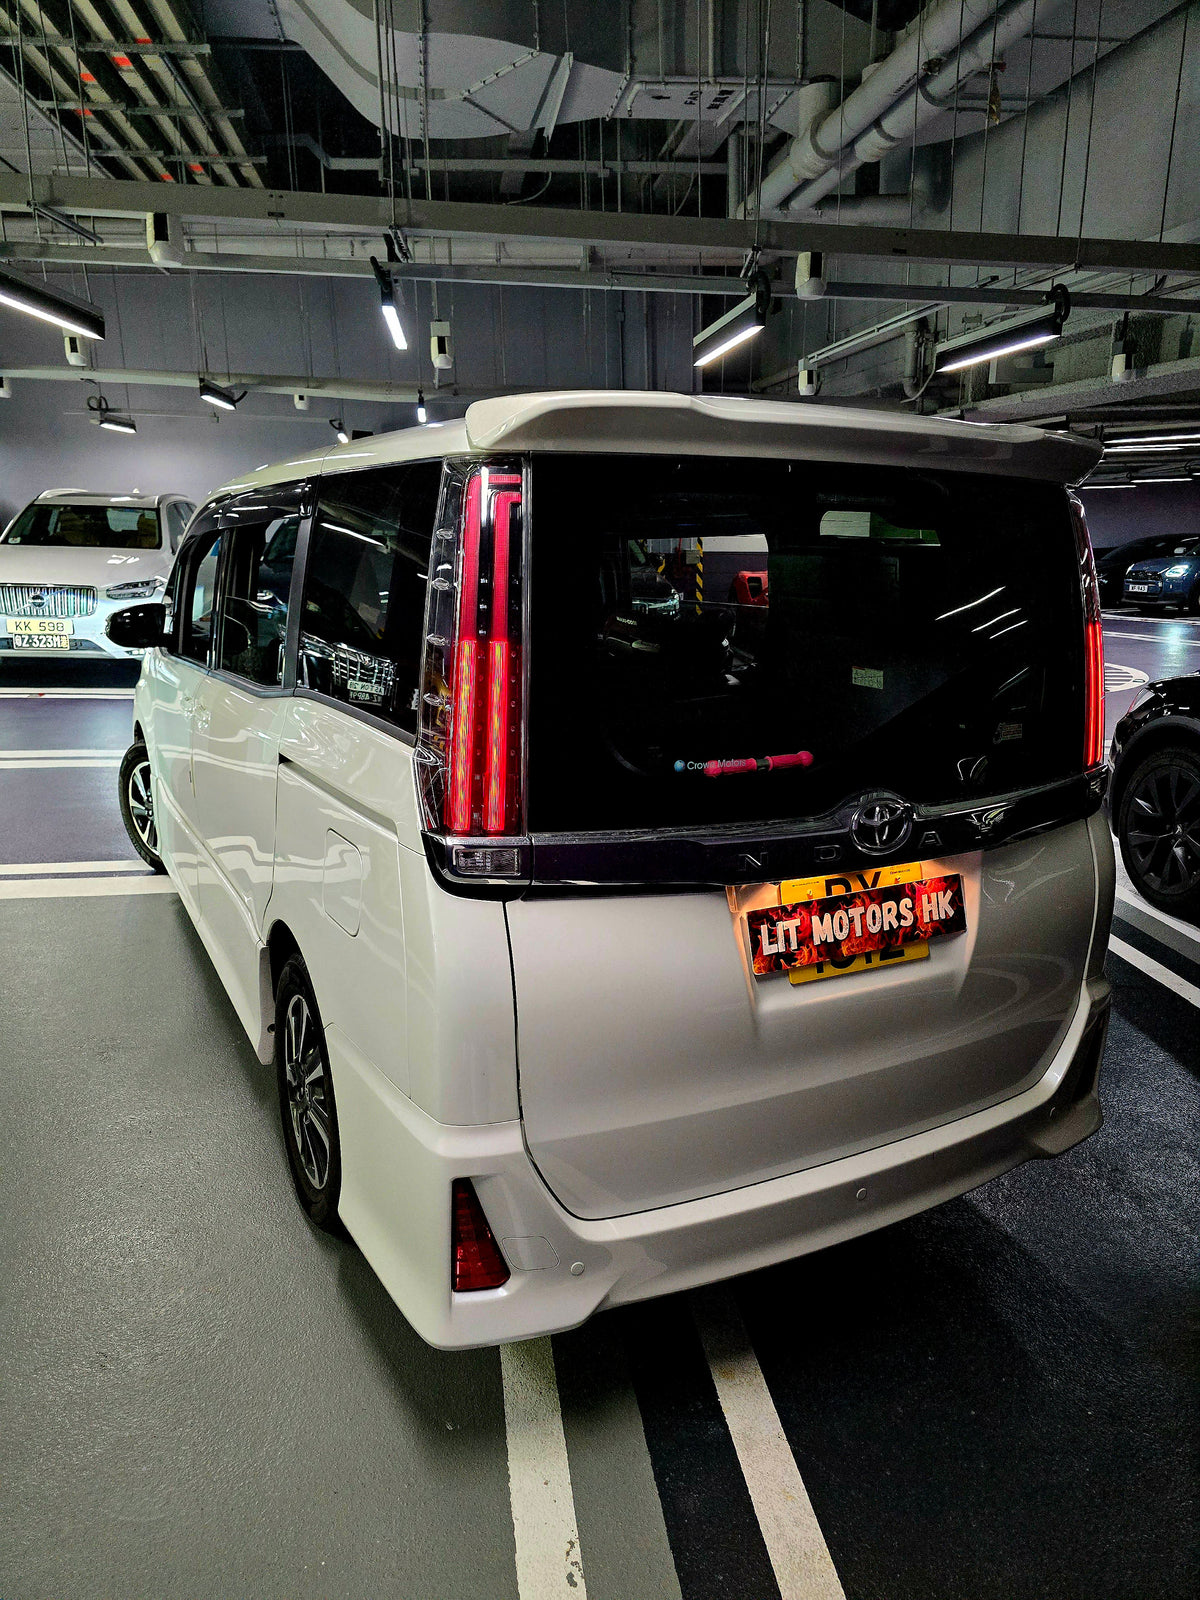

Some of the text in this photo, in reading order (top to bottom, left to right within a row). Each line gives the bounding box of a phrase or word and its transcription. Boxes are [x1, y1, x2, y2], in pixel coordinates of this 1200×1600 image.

[14, 621, 65, 632] KK 598
[687, 759, 746, 770] Crown Motors
[760, 889, 955, 956] LIT MOTORS HK
